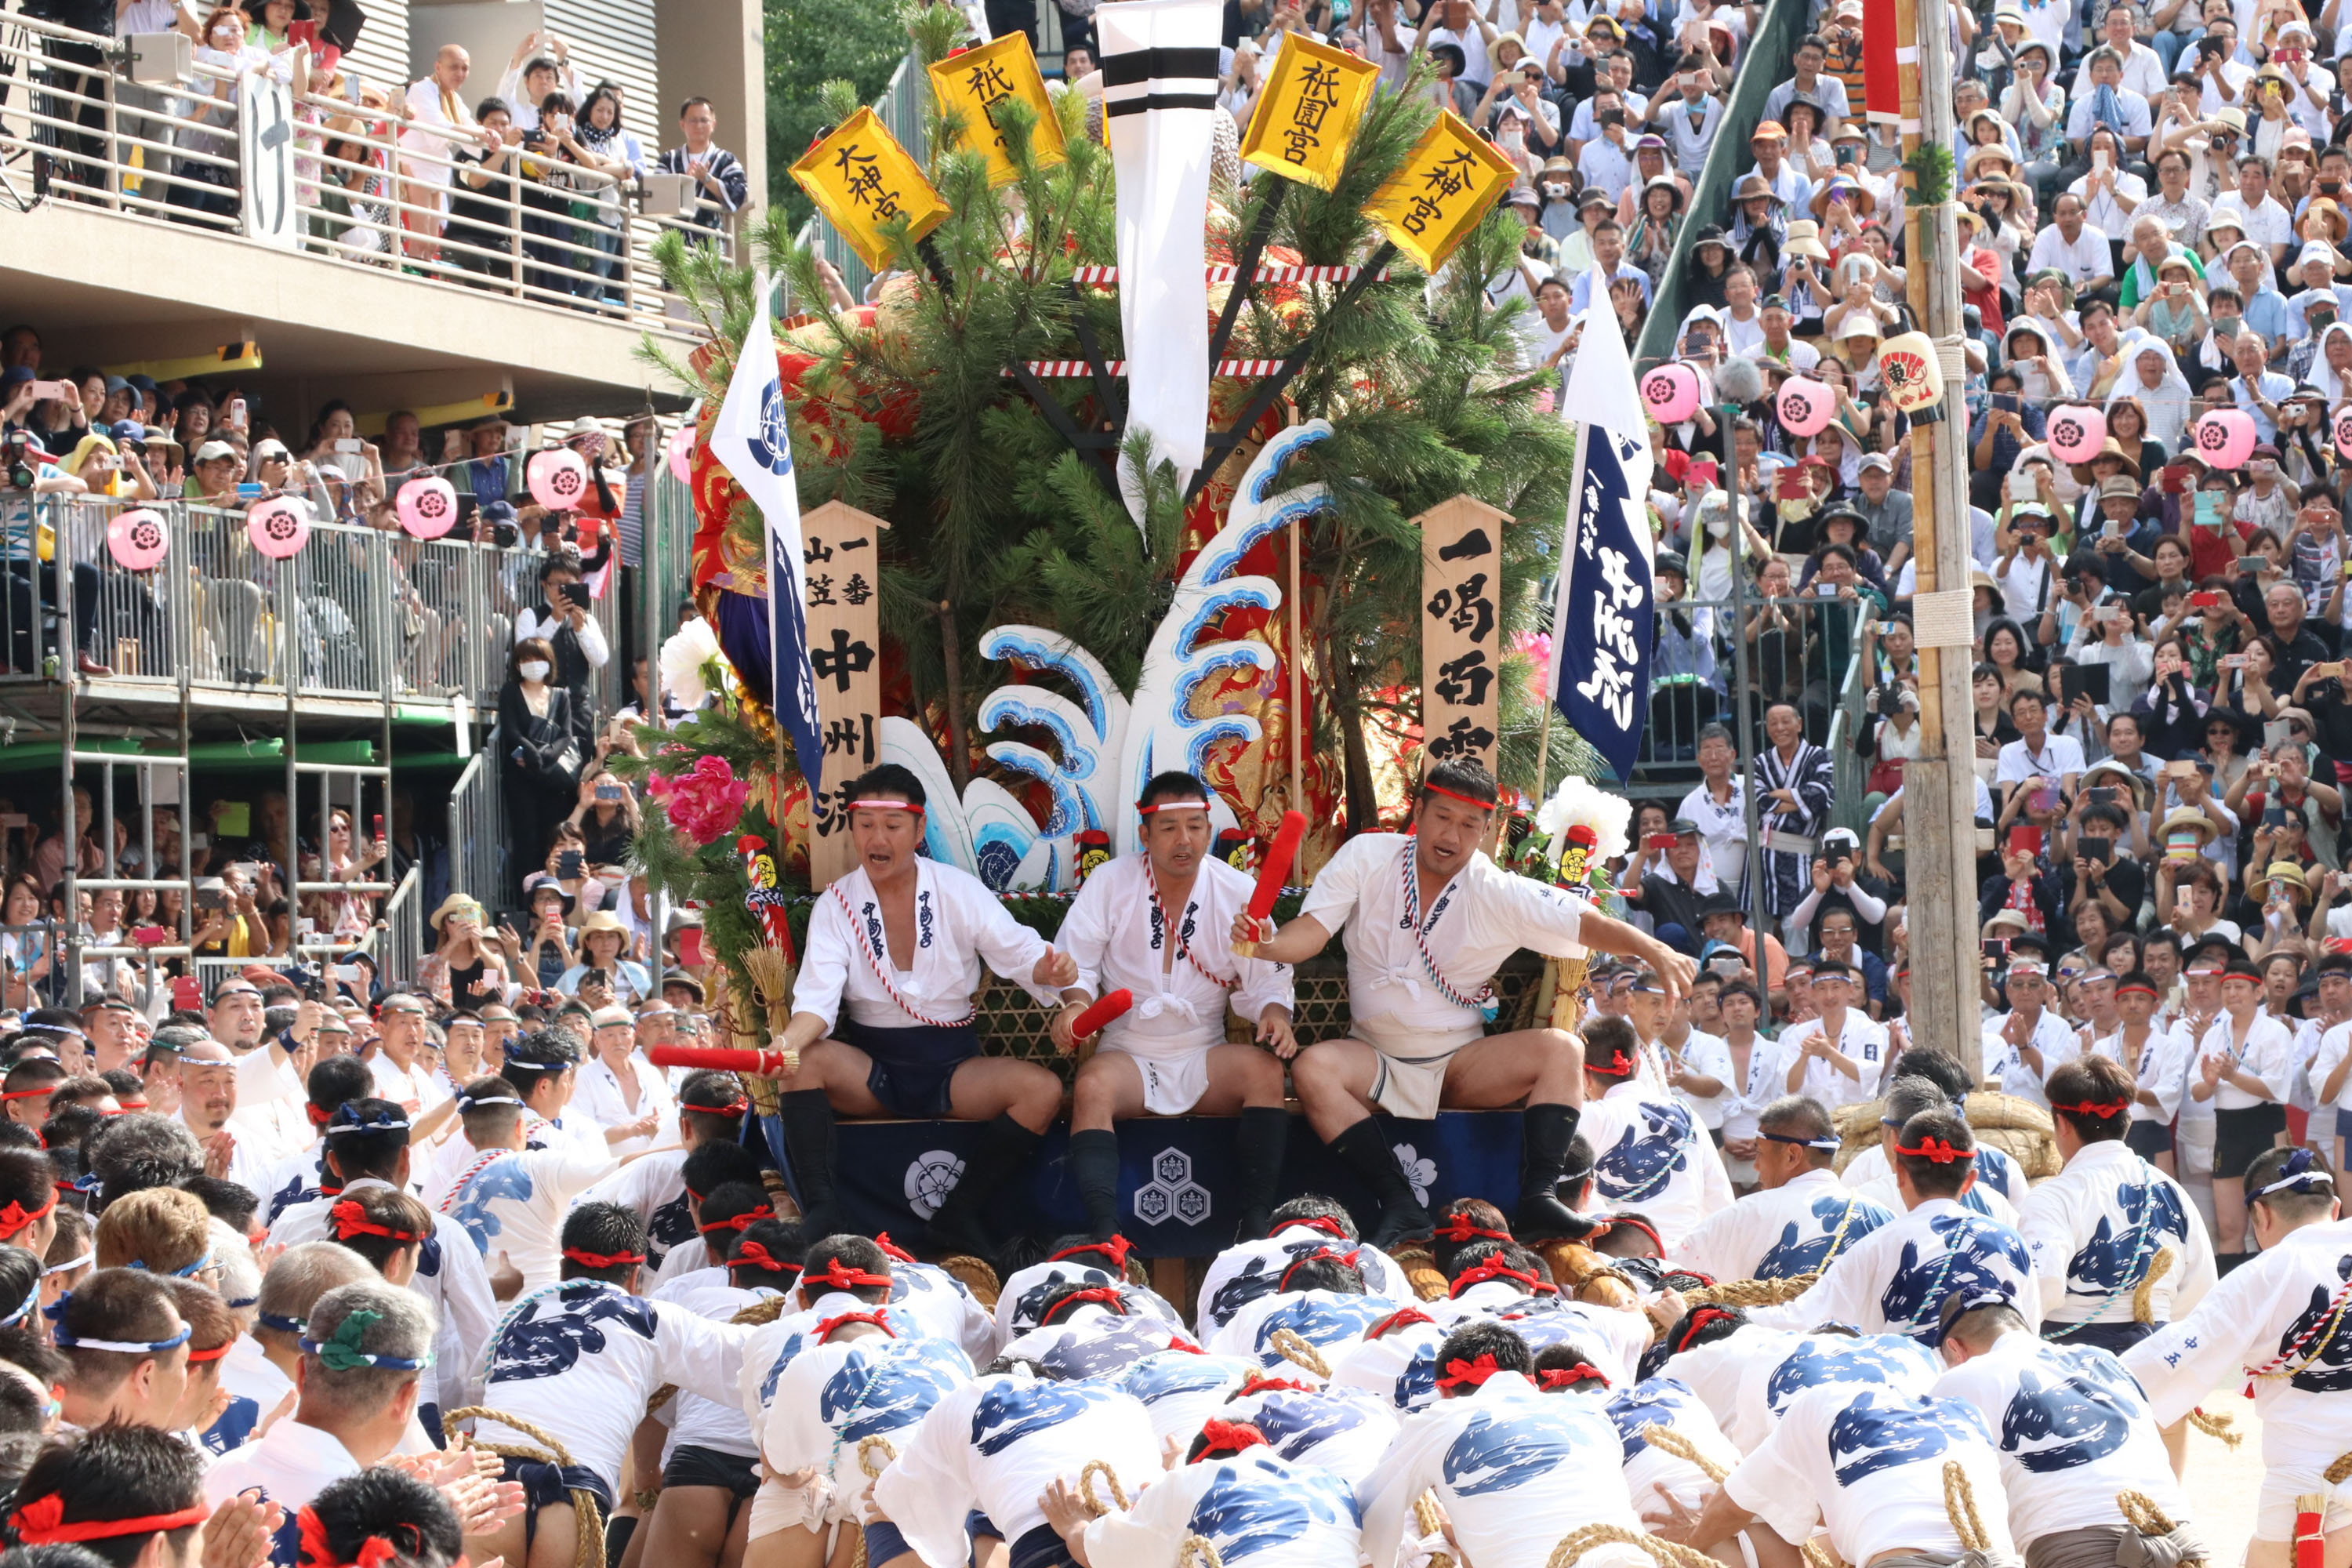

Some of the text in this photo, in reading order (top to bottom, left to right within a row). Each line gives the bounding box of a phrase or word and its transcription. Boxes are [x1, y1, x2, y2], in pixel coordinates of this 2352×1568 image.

[1283, 61, 1340, 166] 祇園宮
[251, 90, 290, 234] け
[1402, 148, 1475, 236] 大神宮
[804, 536, 837, 608] 山笠
[839, 537, 874, 606] 一番
[2164, 1336, 2198, 1370] 中五
